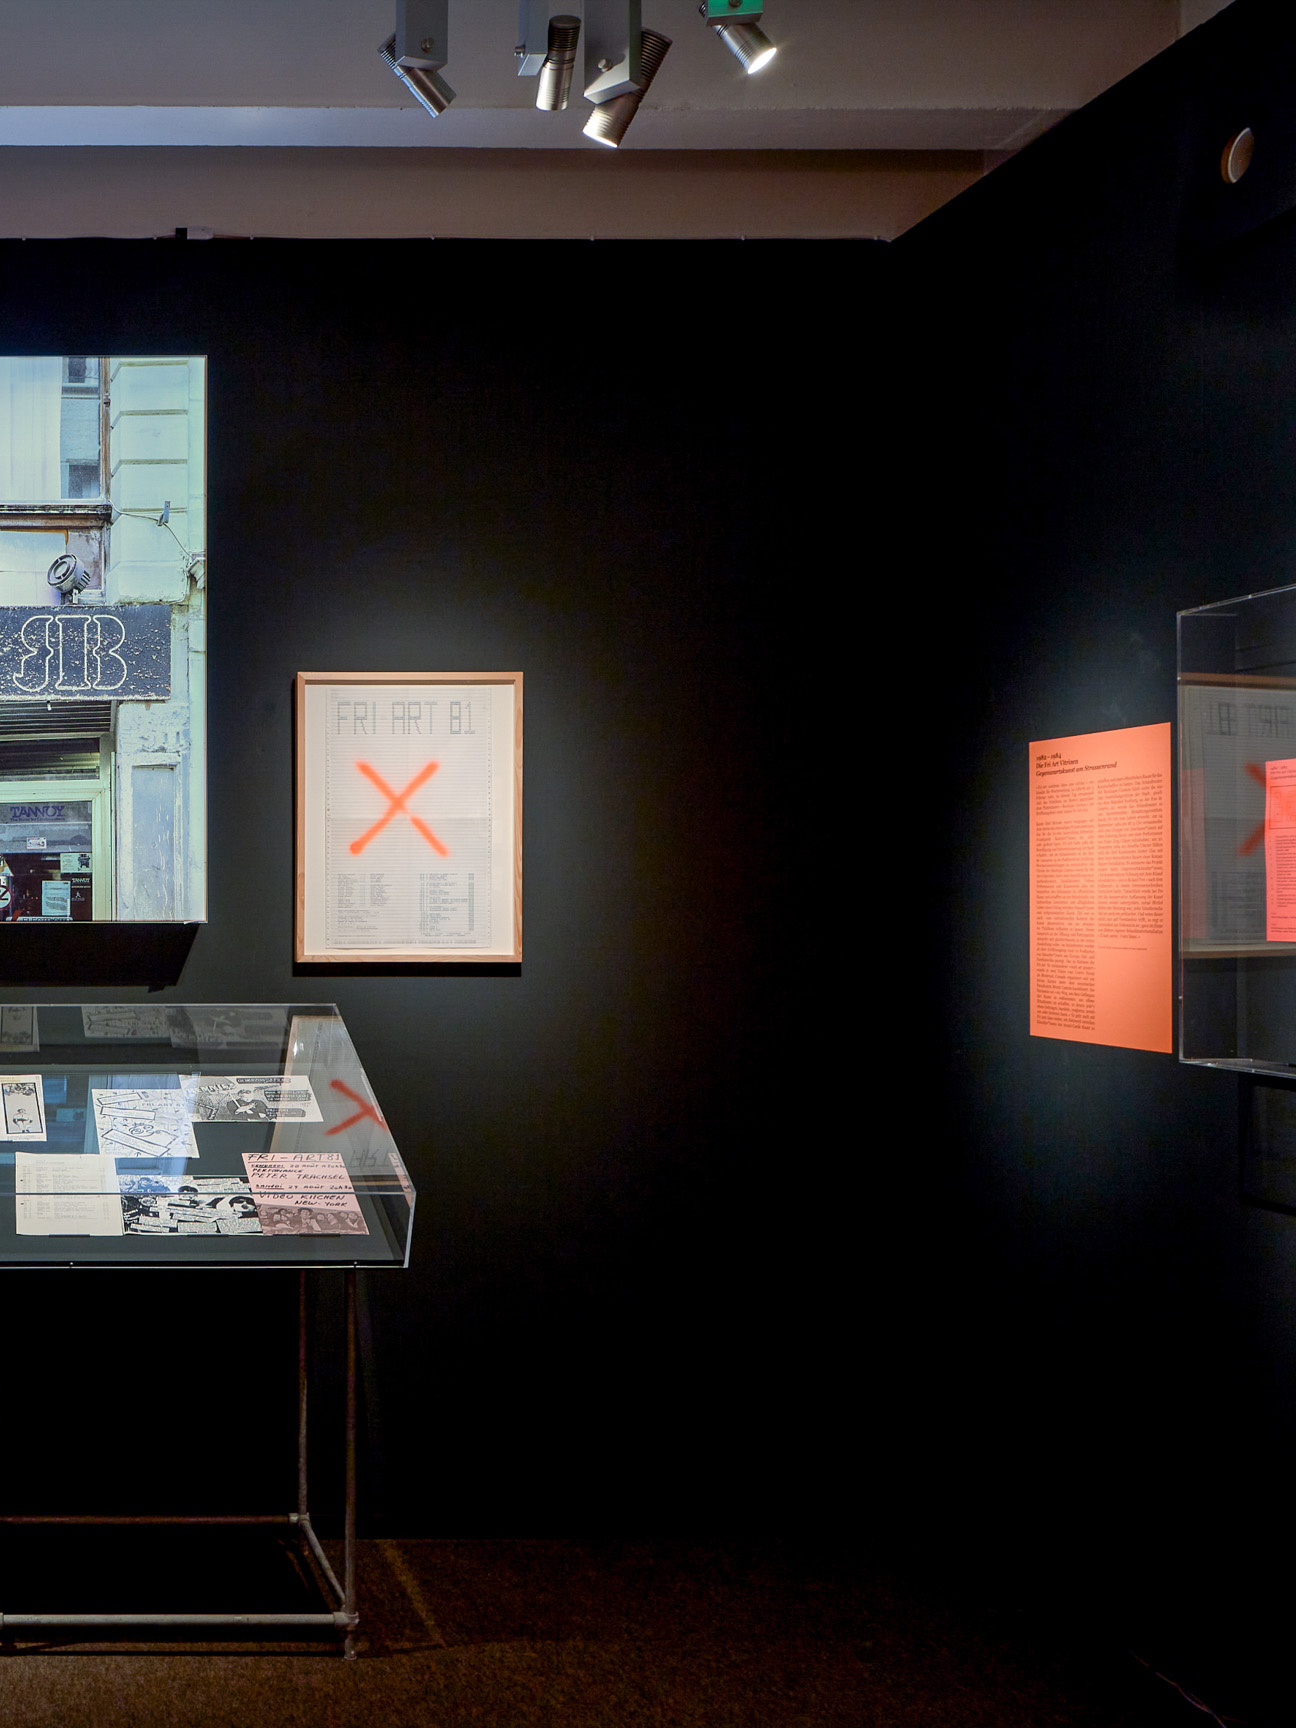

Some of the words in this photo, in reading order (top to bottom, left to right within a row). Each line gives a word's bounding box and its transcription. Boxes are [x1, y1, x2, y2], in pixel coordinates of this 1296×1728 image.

[449, 701, 476, 735] 81
[10, 805, 65, 818] TANNOY
[251, 1172, 288, 1180] PETER
